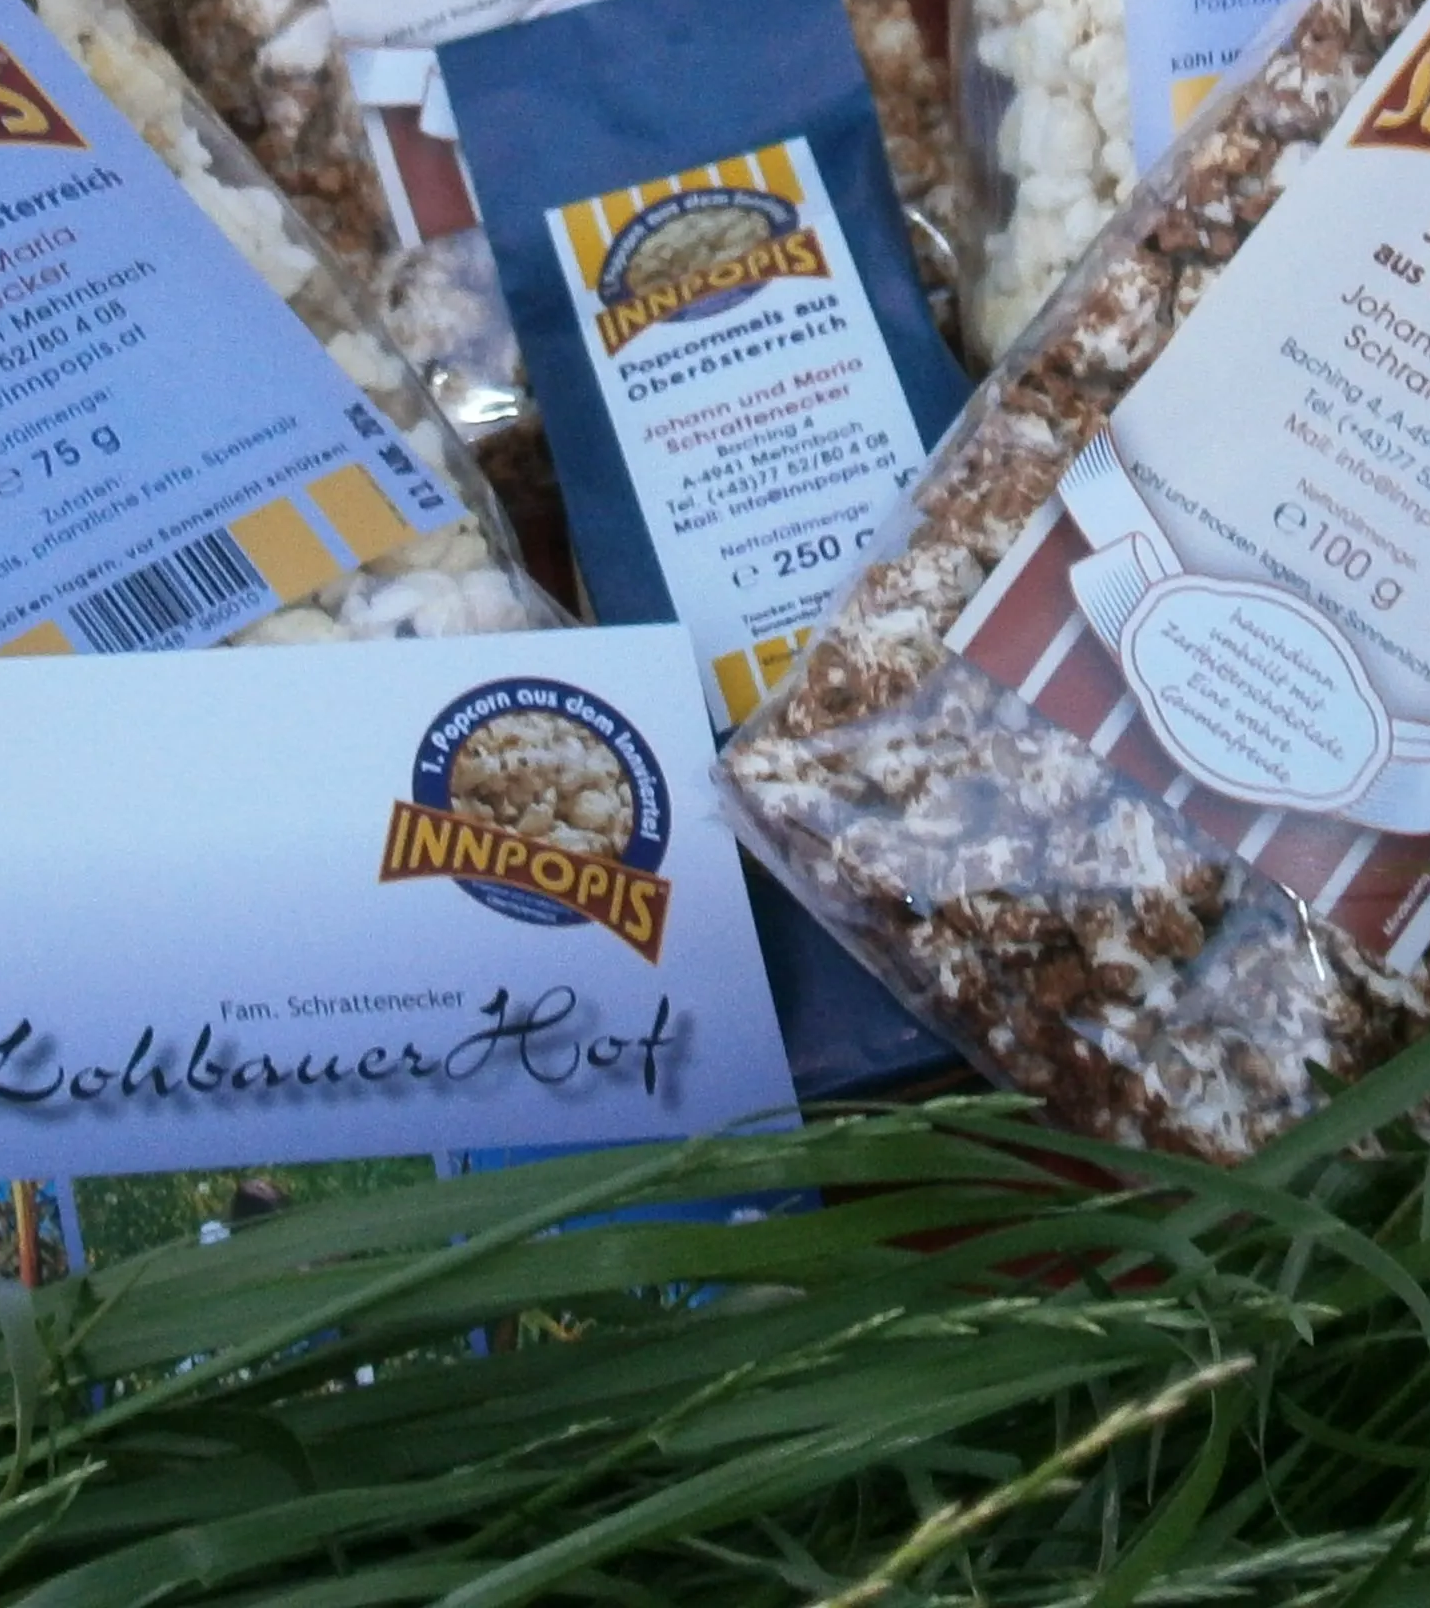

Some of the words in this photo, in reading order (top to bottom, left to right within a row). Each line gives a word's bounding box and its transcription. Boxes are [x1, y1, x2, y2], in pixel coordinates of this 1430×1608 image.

[15, 260, 157, 335] Mehrnbach
[601, 235, 818, 348] INNPOPIS
[1374, 242, 1427, 285] aus
[618, 309, 784, 382] Popcornmais
[796, 293, 839, 317] aus
[628, 314, 847, 403] Oberösterreich
[1281, 337, 1364, 404] Baching
[643, 401, 731, 443] Johann
[739, 377, 787, 408] und
[793, 357, 863, 389] Maria
[666, 384, 851, 455] Schrattenecker
[32, 436, 82, 480] 75
[92, 424, 122, 458] g
[773, 534, 841, 578] 250
[1308, 524, 1372, 579] 100
[1370, 577, 1402, 610] g
[431, 691, 512, 750] Popcorn
[517, 688, 559, 708] aus
[565, 695, 615, 736] dem
[390, 808, 656, 942] INNPOPIS
[220, 1000, 277, 1023] Fam.
[286, 991, 465, 1020] Schrattenecker
